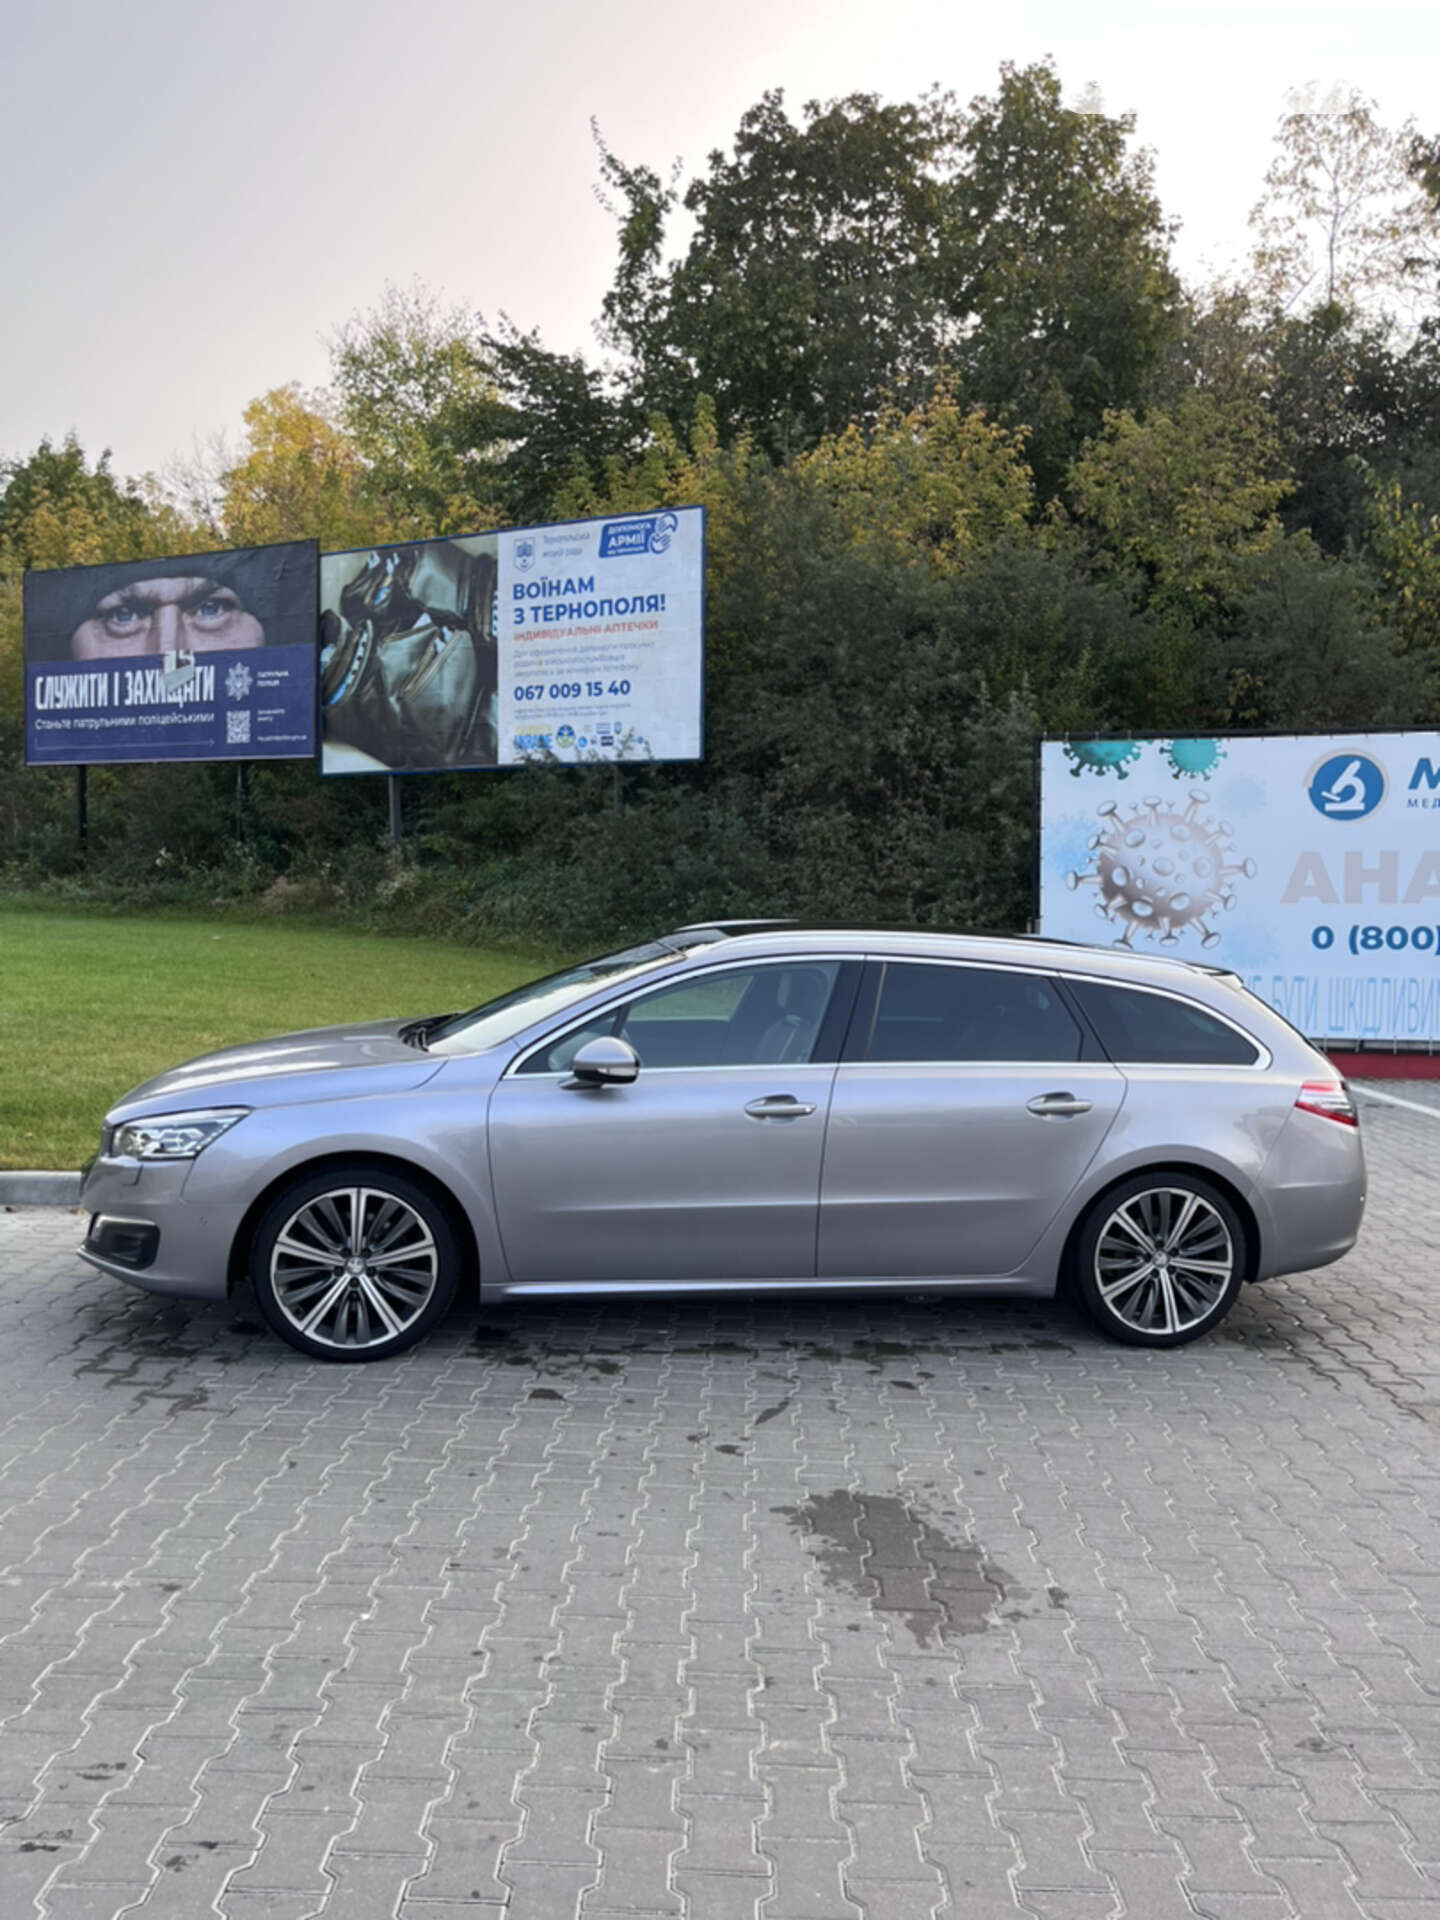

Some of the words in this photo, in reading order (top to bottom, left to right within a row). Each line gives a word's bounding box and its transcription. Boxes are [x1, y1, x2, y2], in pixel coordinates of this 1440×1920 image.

[608, 530, 645, 549] АРМІЇ
[513, 576, 595, 600] ВОЇНАМ
[513, 607, 525, 625] З
[530, 594, 667, 623] ТЕРНОПОЛЯ!
[603, 620, 659, 633] АПТЕЧКИ
[35, 672, 108, 710] СЛУЖИТИ
[113, 671, 120, 706] І
[514, 685, 544, 701] 067
[549, 682, 581, 699] 009
[586, 681, 603, 697] 15
[608, 679, 631, 696] 40
[35, 718, 71, 731] Станьте
[139, 712, 215, 727] поліцейськими
[1312, 925, 1334, 950] 0
